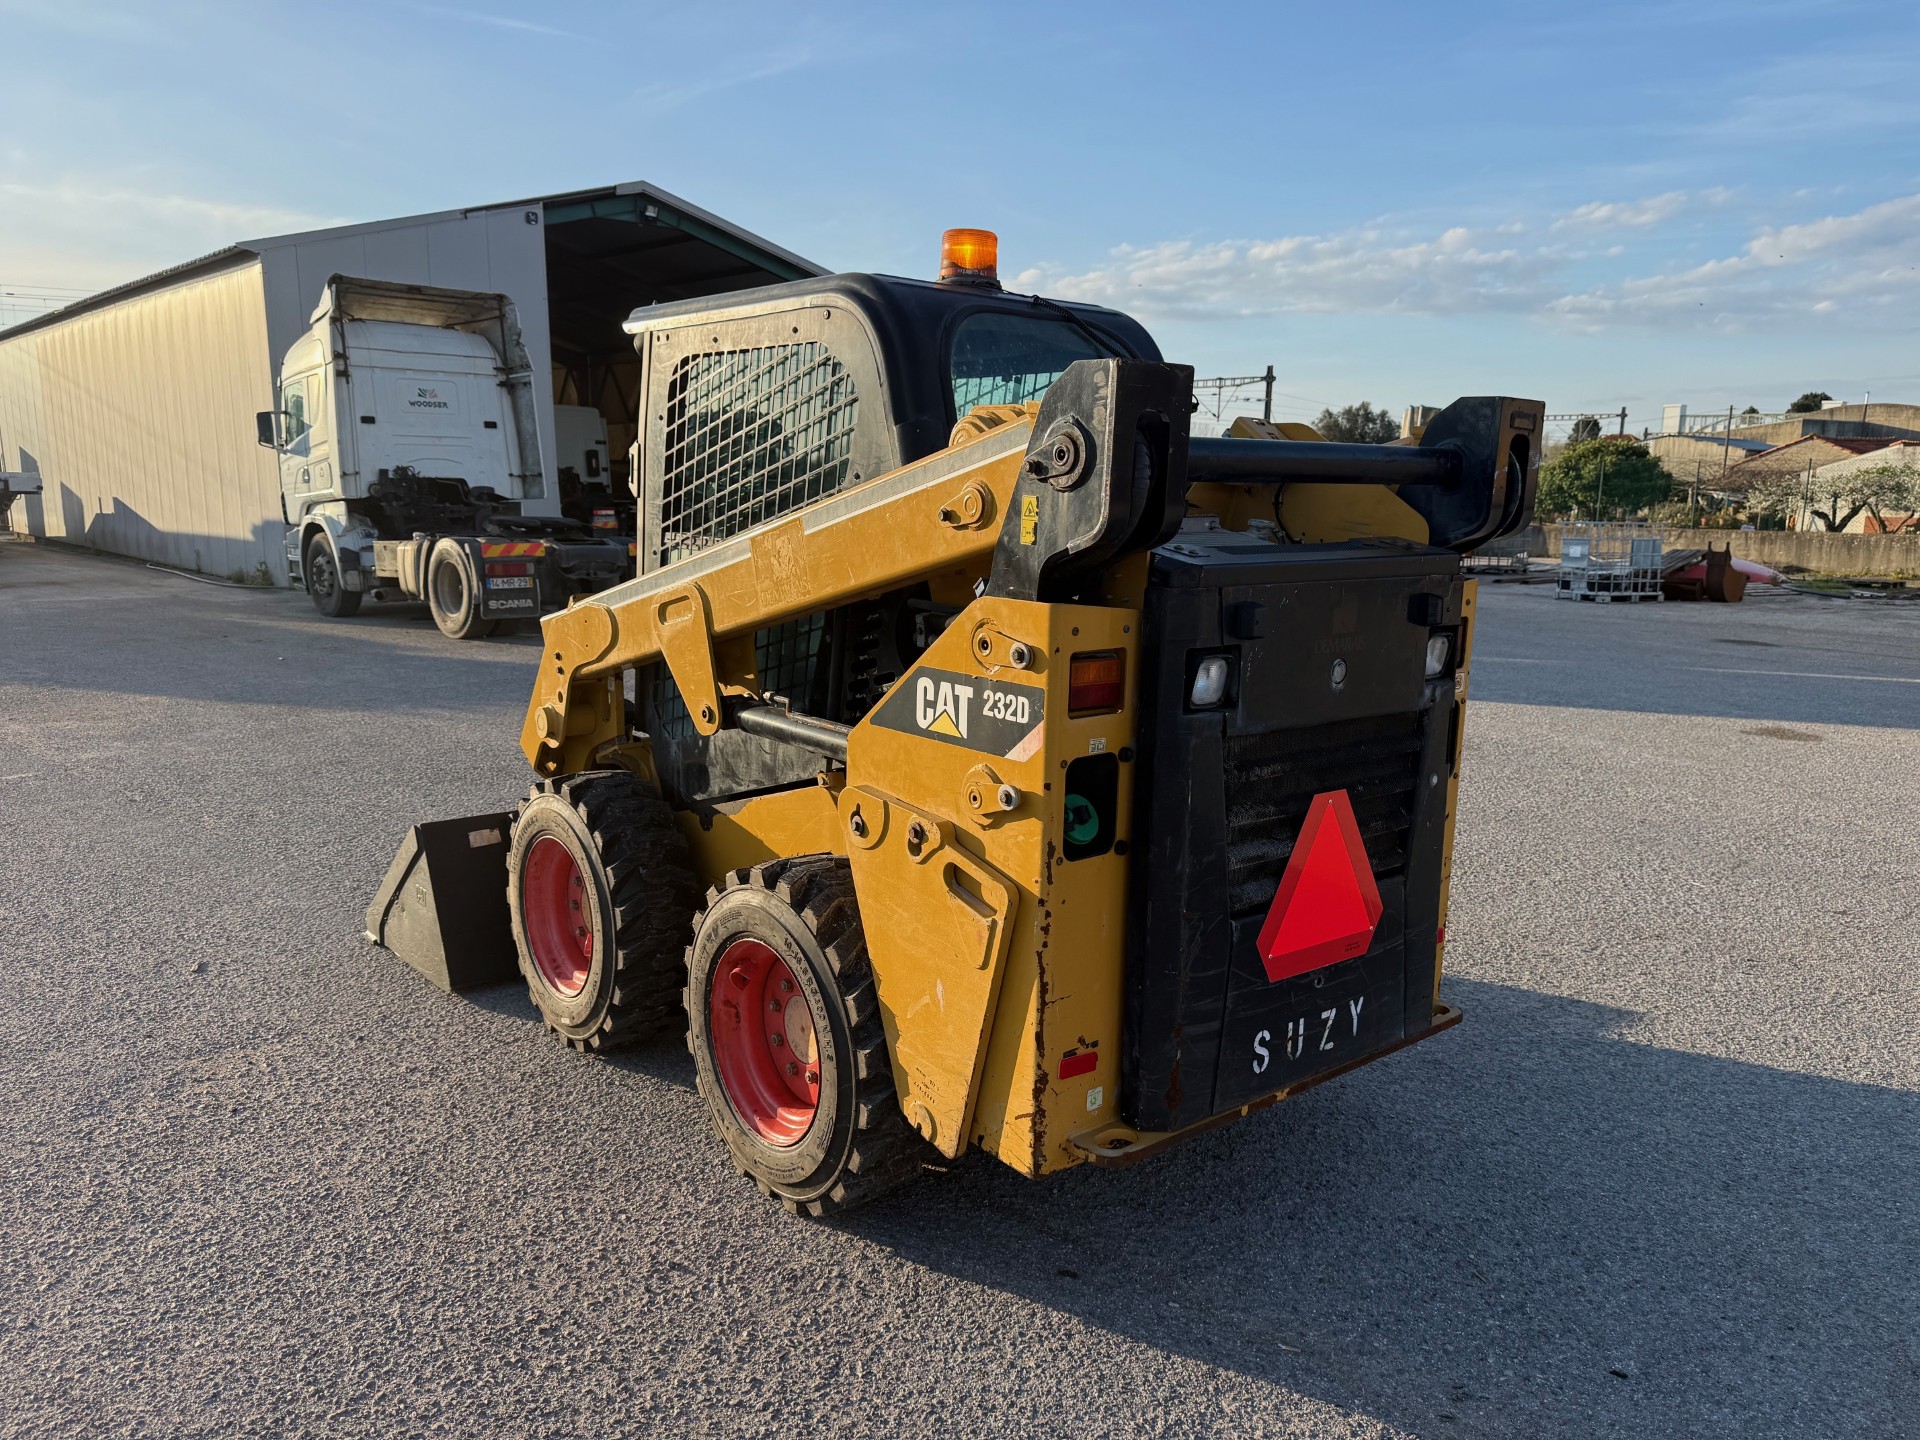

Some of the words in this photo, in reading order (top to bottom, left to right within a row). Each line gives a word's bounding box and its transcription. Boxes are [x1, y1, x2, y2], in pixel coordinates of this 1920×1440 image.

[408, 400, 448, 409] WOODSER
[491, 577, 529, 588] 14-MR-29
[488, 599, 533, 609] SCANIA
[916, 676, 974, 739] CAT
[982, 690, 1030, 724] 232D
[1252, 996, 1364, 1074] SUZY
